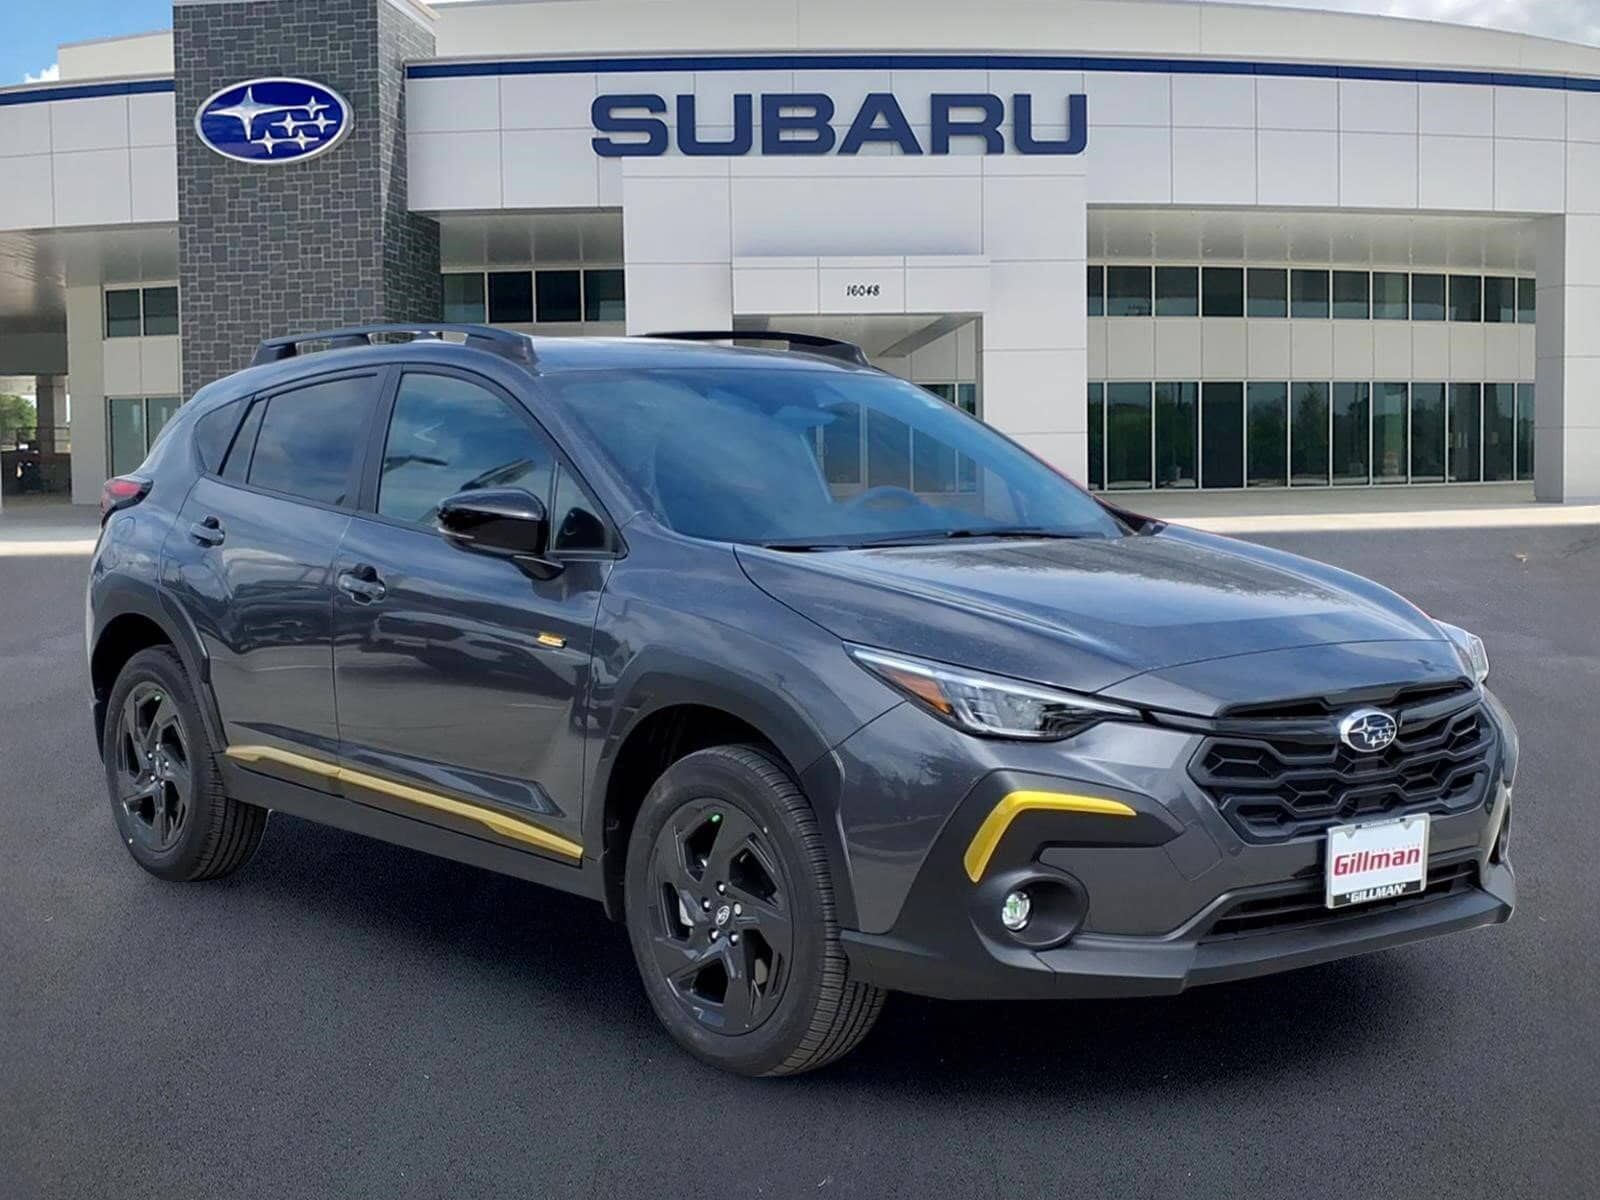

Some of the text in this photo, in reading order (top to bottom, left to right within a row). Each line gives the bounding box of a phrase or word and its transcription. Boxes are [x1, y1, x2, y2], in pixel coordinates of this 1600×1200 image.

[591, 93, 1088, 157] SUBARU
[846, 284, 880, 297] 16048
[1333, 848, 1421, 877] Gillman
